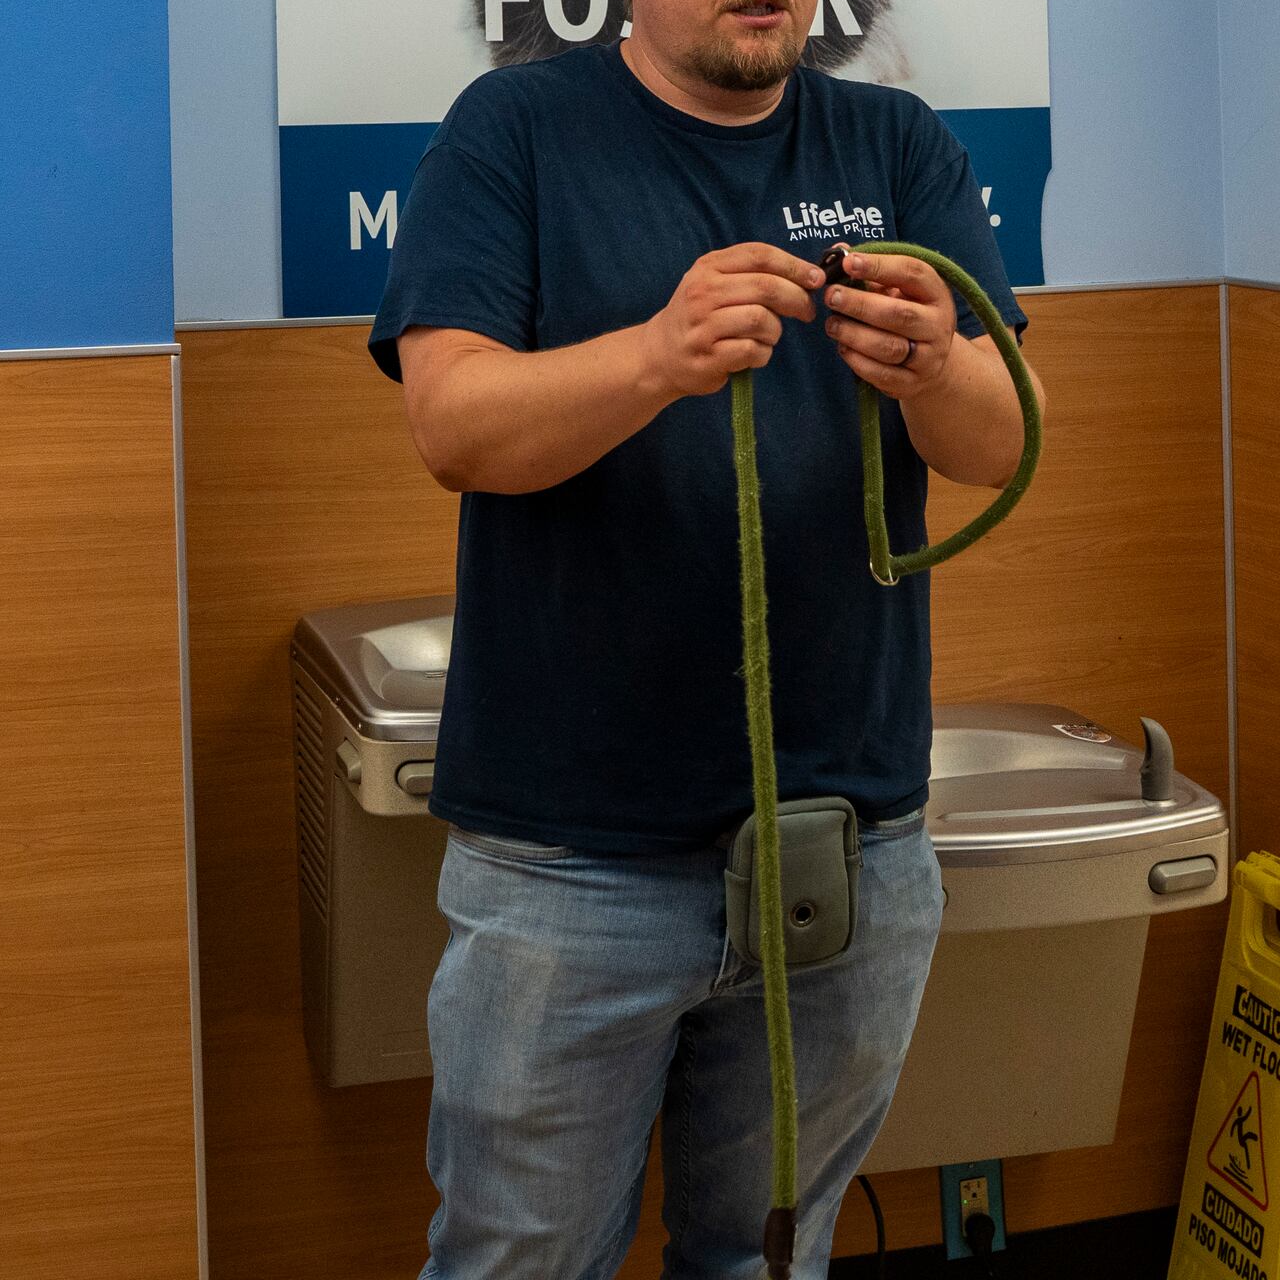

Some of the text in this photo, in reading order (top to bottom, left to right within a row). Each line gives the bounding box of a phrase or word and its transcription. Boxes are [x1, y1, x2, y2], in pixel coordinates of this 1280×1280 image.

[782, 200, 884, 230] LifeLne
[789, 227, 840, 242] ANIMAL
[1222, 1021, 1253, 1057] WET
[1188, 1213, 1216, 1253] PISO
[1205, 1189, 1261, 1251] CUIDADO
